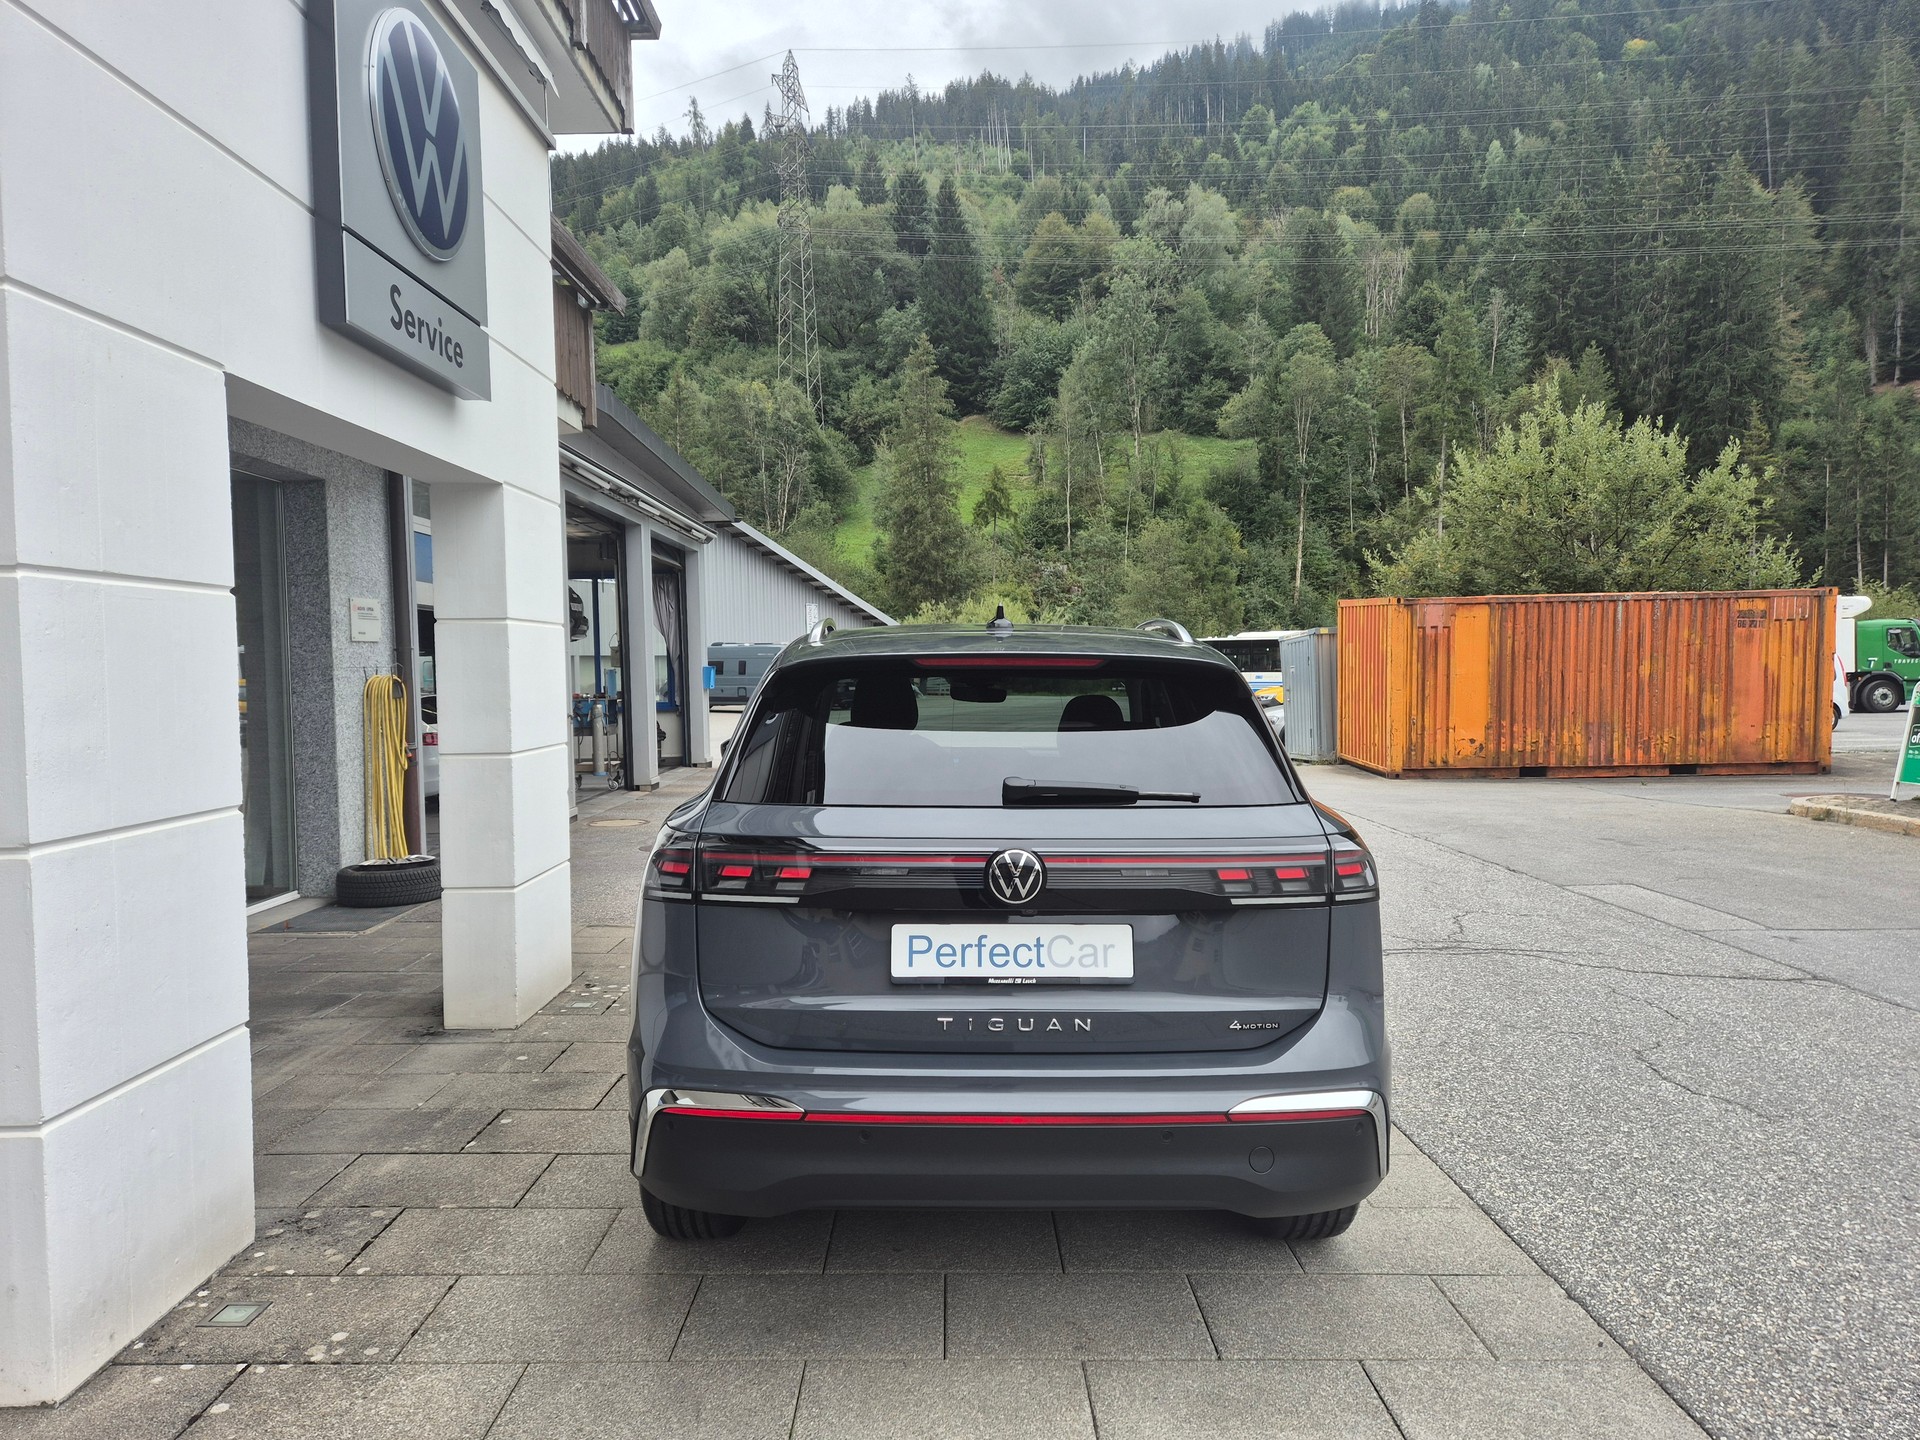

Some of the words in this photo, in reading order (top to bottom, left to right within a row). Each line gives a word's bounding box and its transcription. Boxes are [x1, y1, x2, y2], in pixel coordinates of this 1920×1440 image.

[389, 283, 464, 368] Service
[907, 934, 1116, 969] PerfectCar
[1229, 1020, 1279, 1031] 4MOTION
